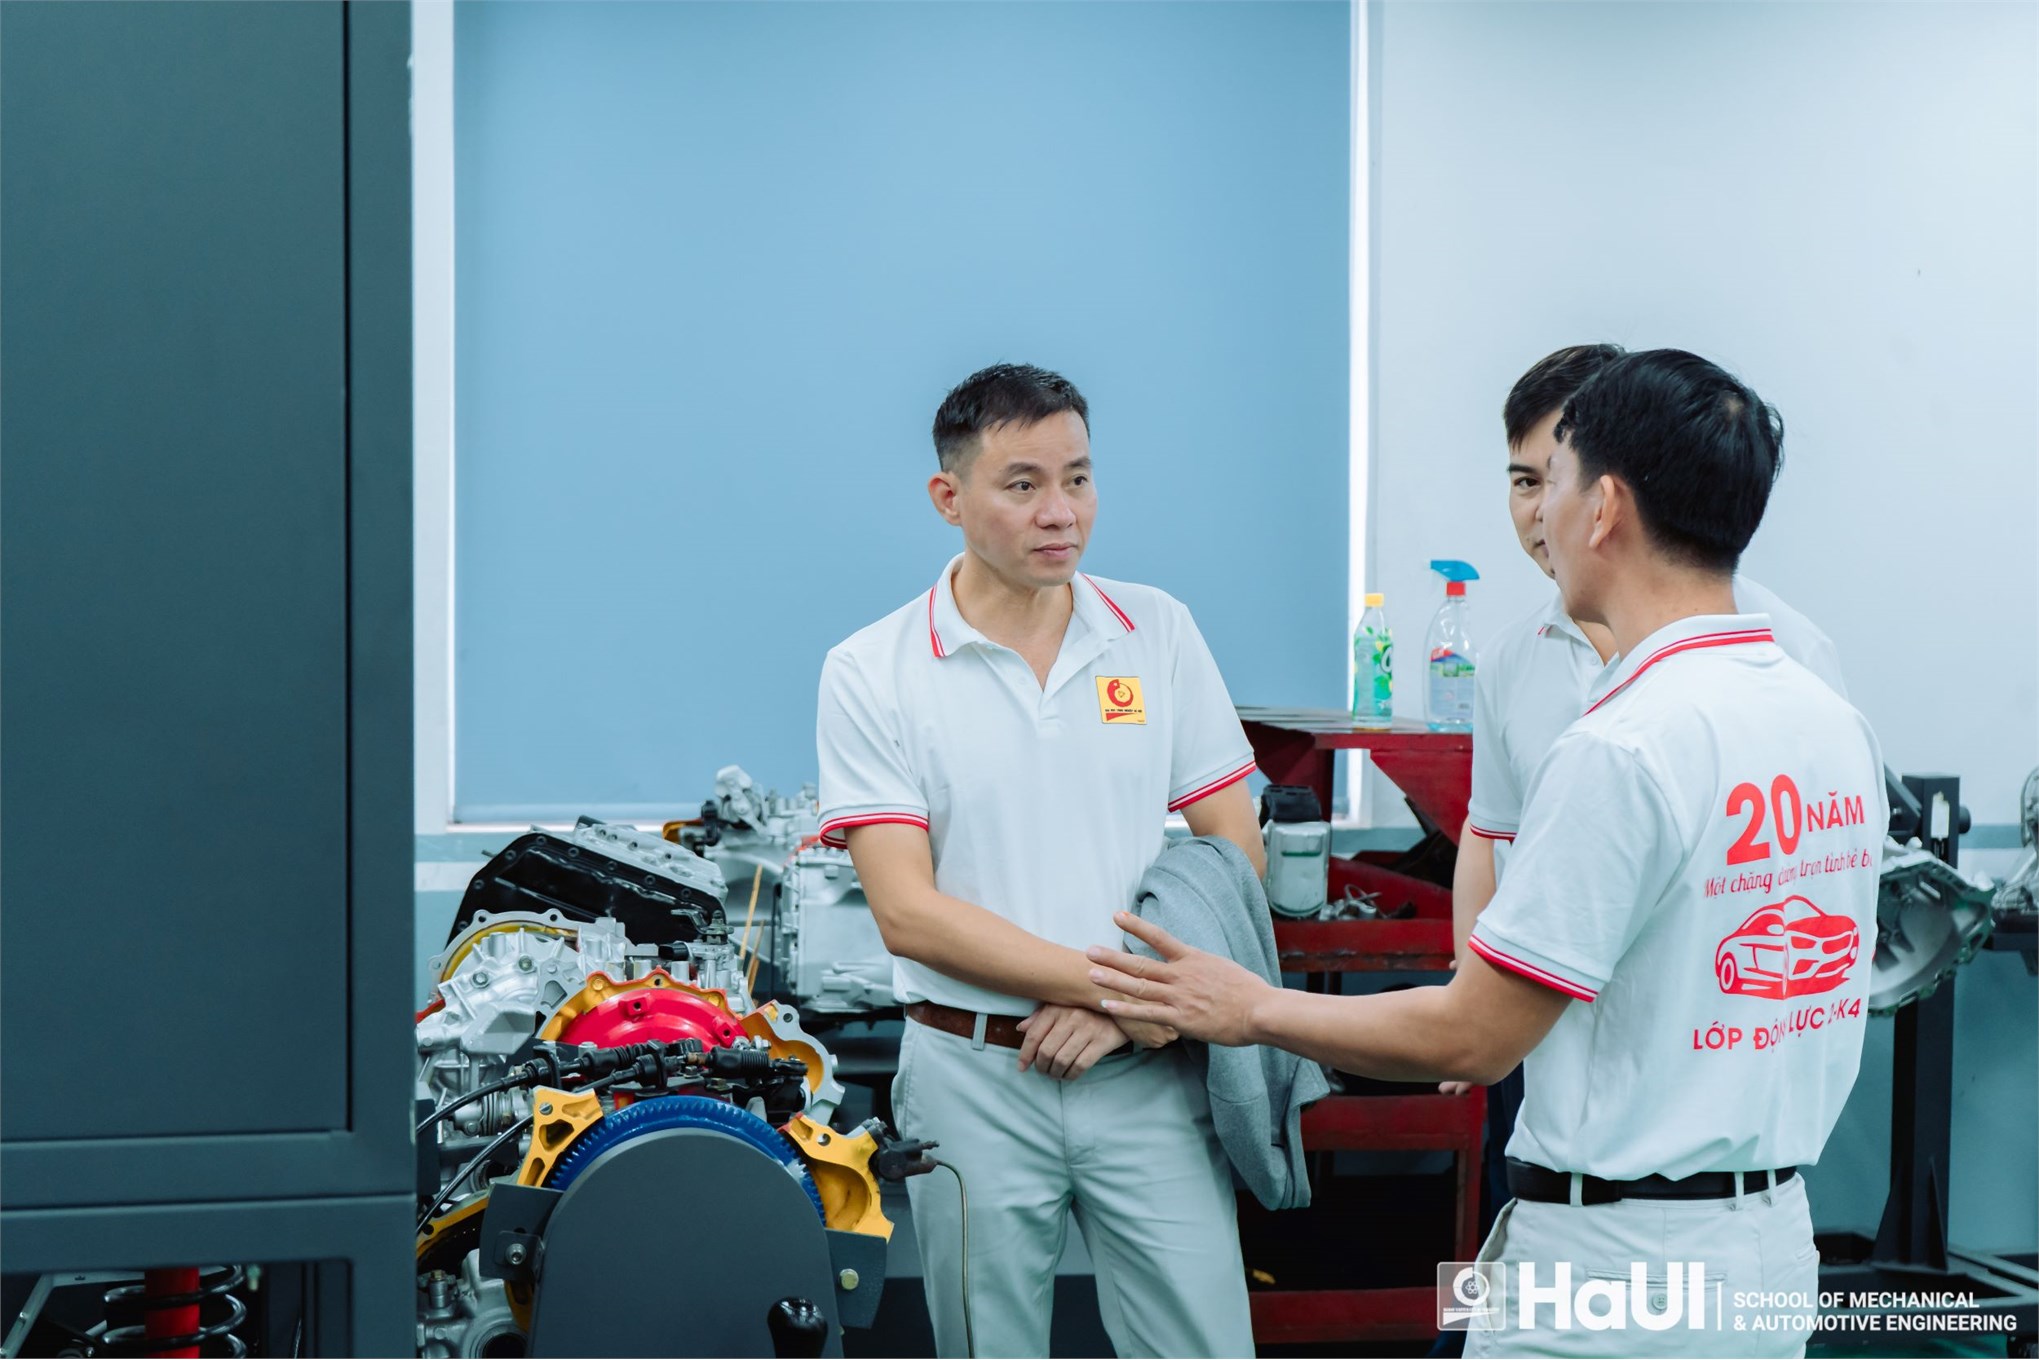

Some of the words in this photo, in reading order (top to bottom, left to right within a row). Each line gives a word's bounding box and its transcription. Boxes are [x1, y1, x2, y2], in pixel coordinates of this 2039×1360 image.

[1726, 774, 1802, 866] 20
[1807, 790, 1865, 833] NĂM
[1693, 1020, 1744, 1050] LỚP
[1788, 1004, 1825, 1037] LỰC
